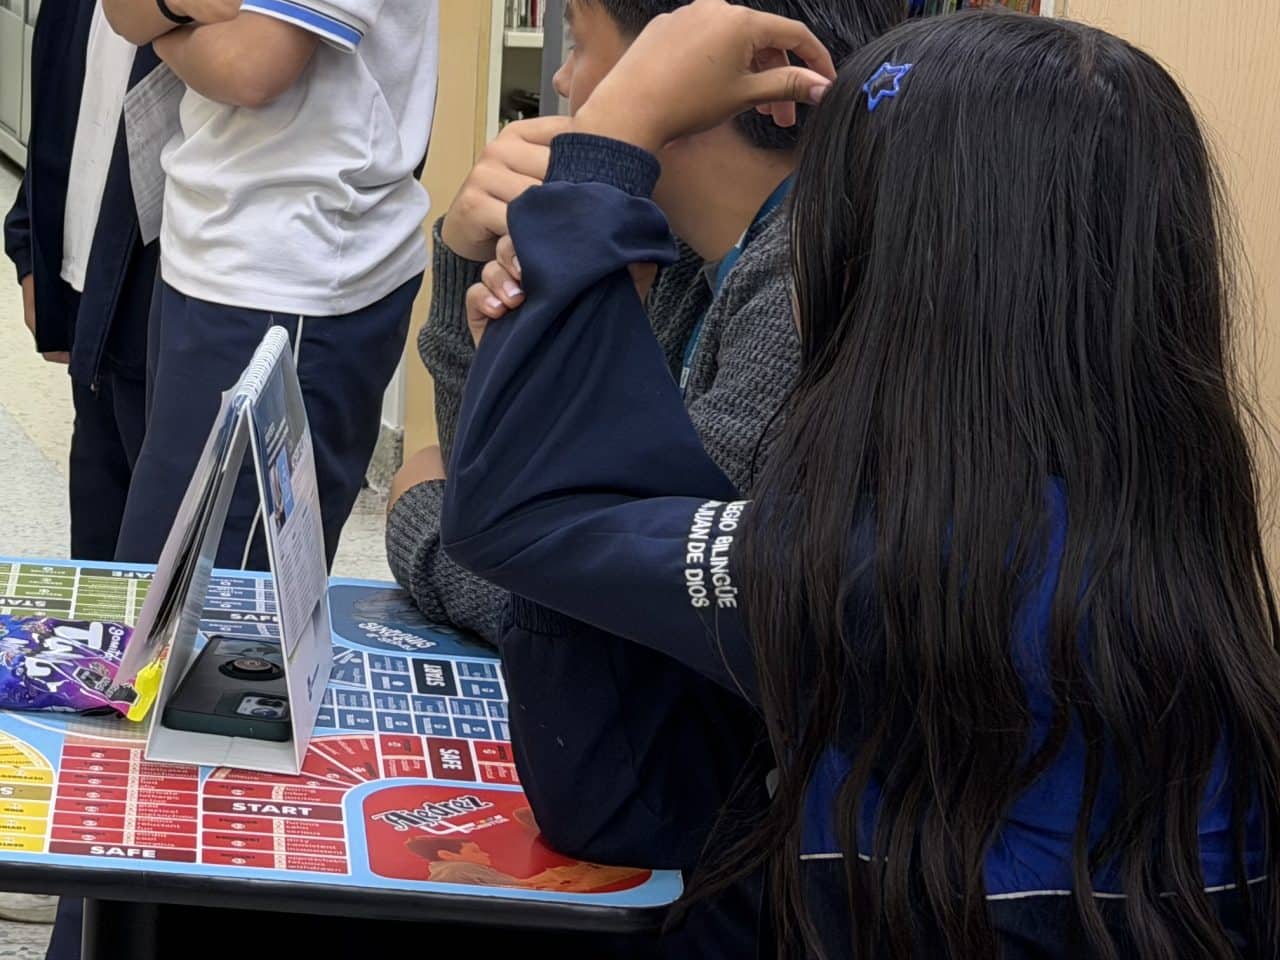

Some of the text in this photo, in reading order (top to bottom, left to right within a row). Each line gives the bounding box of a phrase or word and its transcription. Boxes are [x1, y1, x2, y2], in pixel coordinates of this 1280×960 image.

[686, 542, 706, 564] DE
[685, 568, 710, 607] DIOS
[423, 663, 446, 687] START
[439, 748, 463, 771] SAFE
[232, 802, 313, 816] START
[90, 845, 156, 858] SAFE
